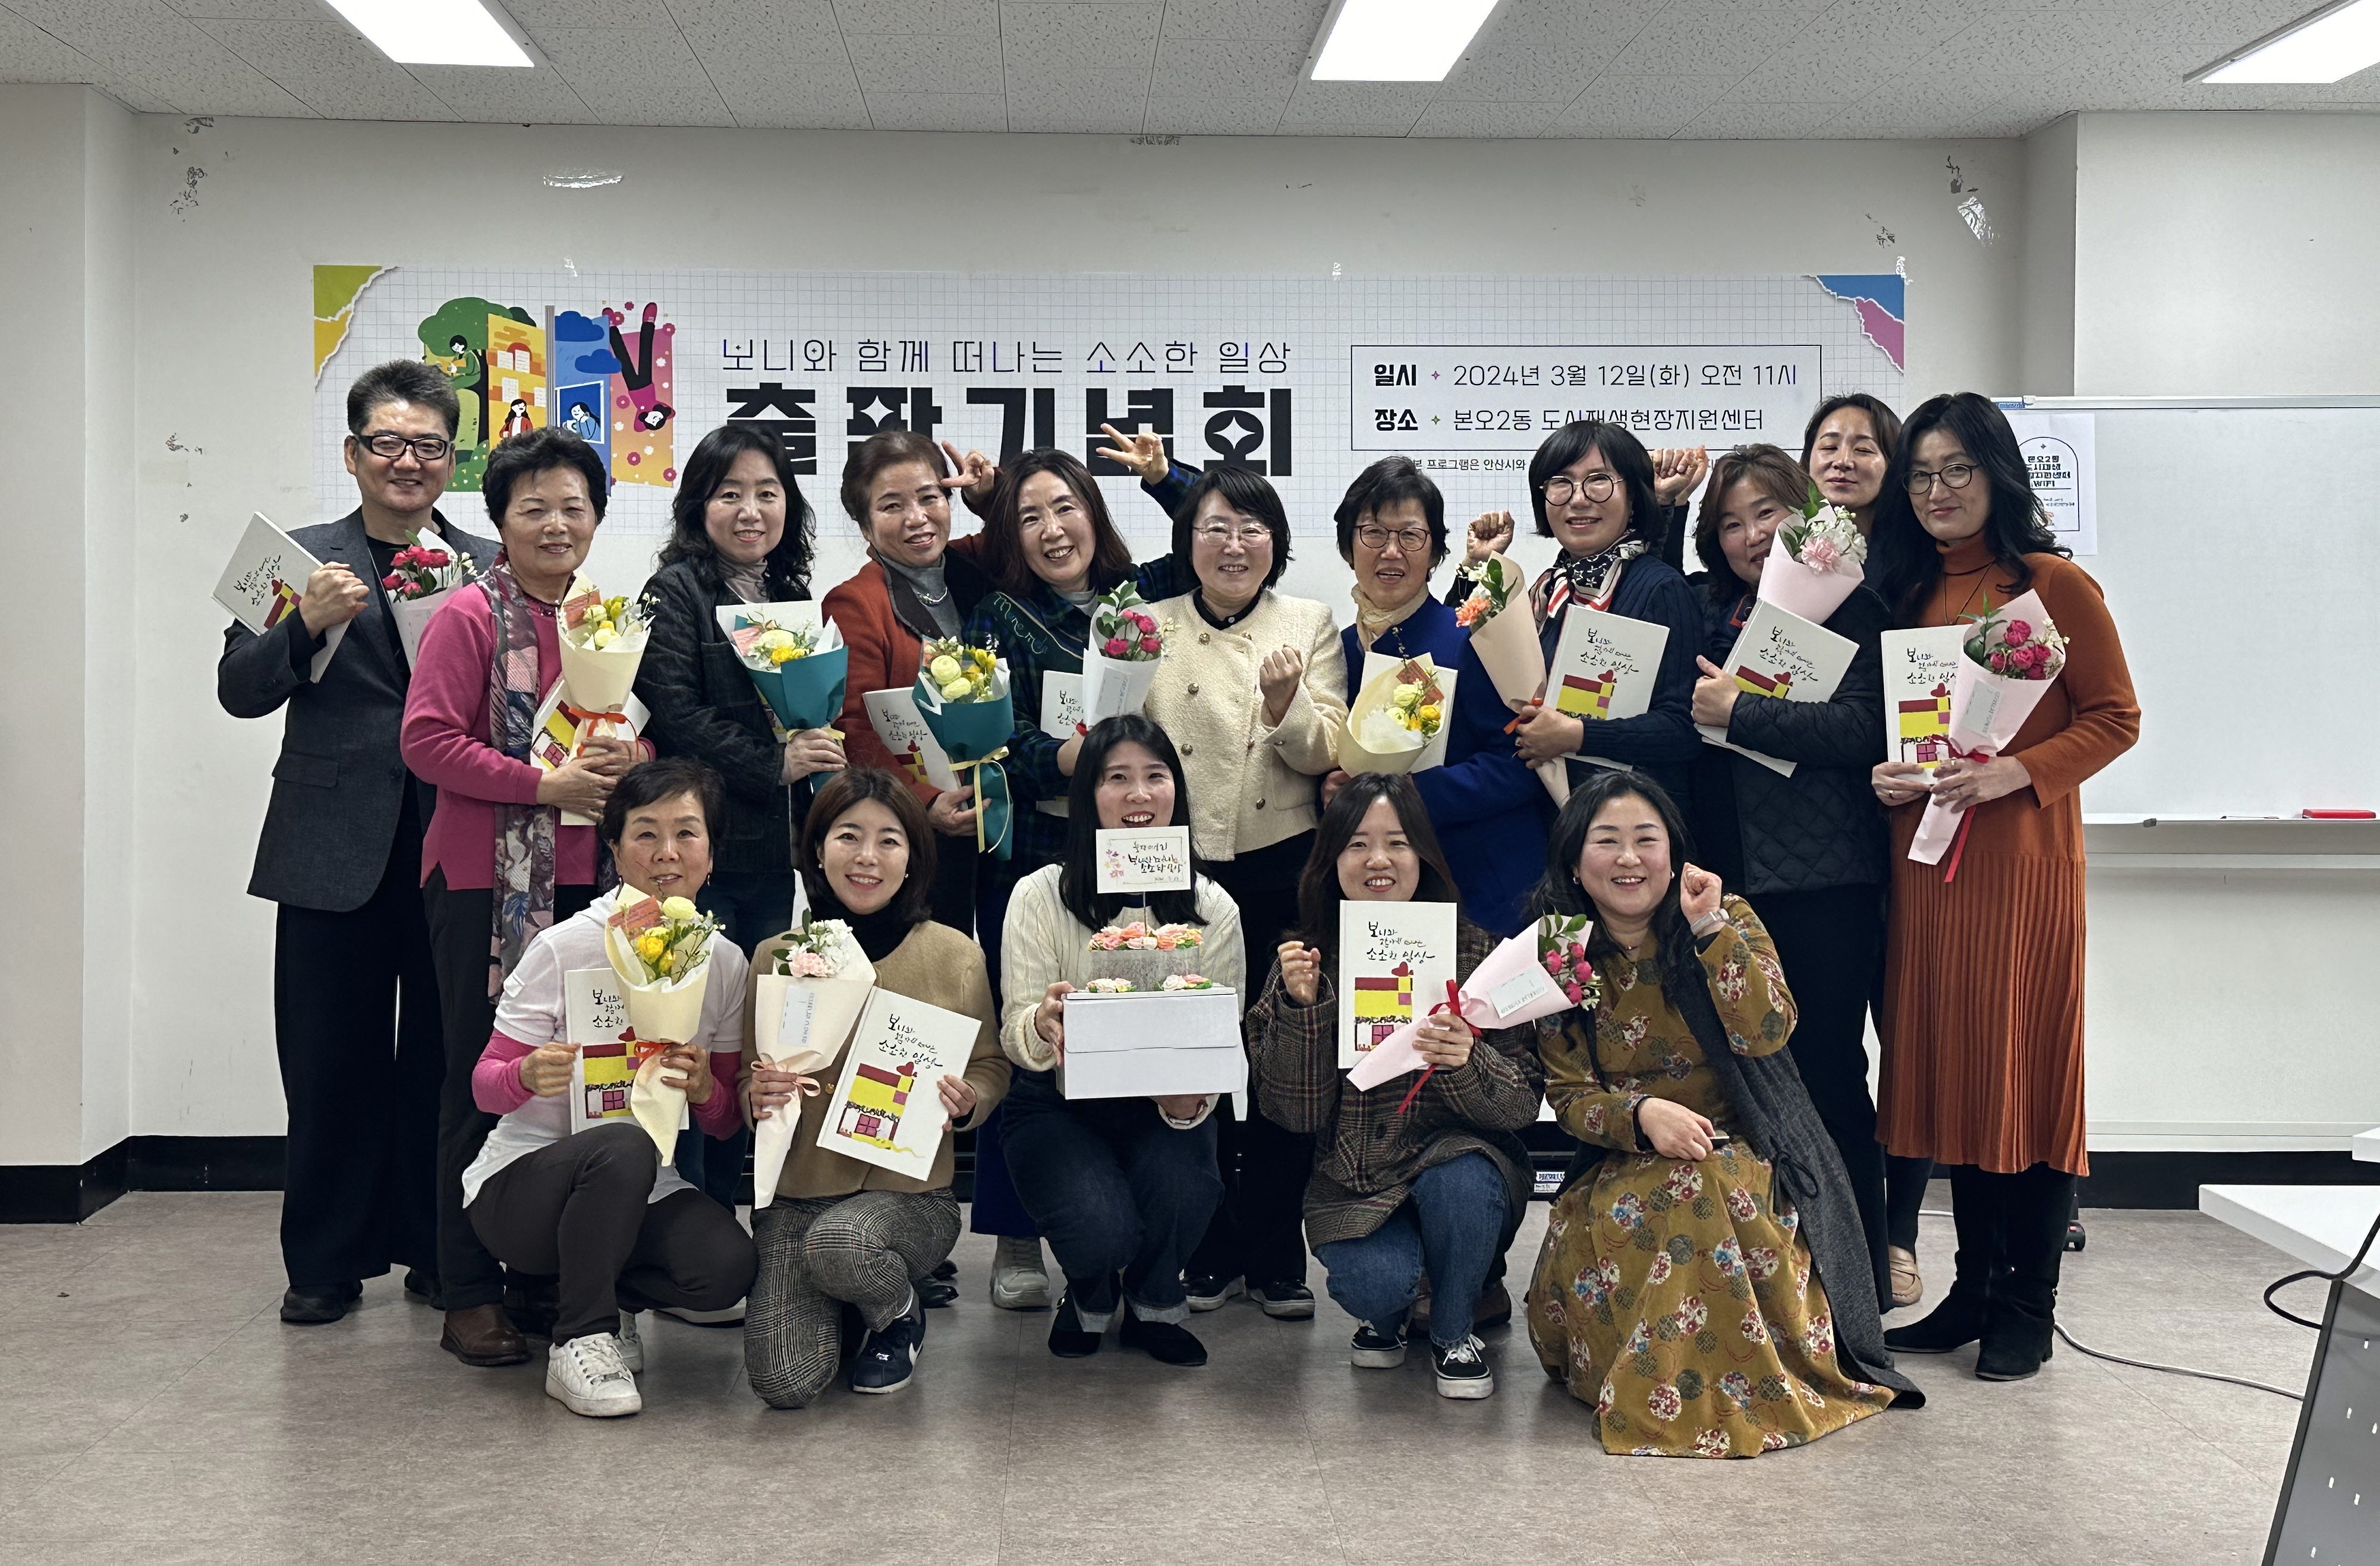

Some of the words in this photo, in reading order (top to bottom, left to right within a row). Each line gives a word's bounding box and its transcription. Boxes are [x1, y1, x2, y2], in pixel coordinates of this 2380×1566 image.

[723, 339, 837, 372] 보니와
[858, 339, 929, 372] 함께
[953, 341, 1062, 373] 떠나는
[1086, 341, 1198, 373] 소소한
[1219, 342, 1291, 373] 일상
[1374, 364, 1416, 386] 일시
[1454, 365, 1540, 386] 2024년
[1551, 365, 1586, 386] 3월
[1598, 364, 1689, 388] 12일(화)
[1701, 365, 1741, 386] 오전
[1753, 364, 1796, 385] 11시
[1374, 409, 1418, 431] 장소
[1453, 409, 1532, 431] 본오2동
[1483, 459, 1525, 471] 안산시와
